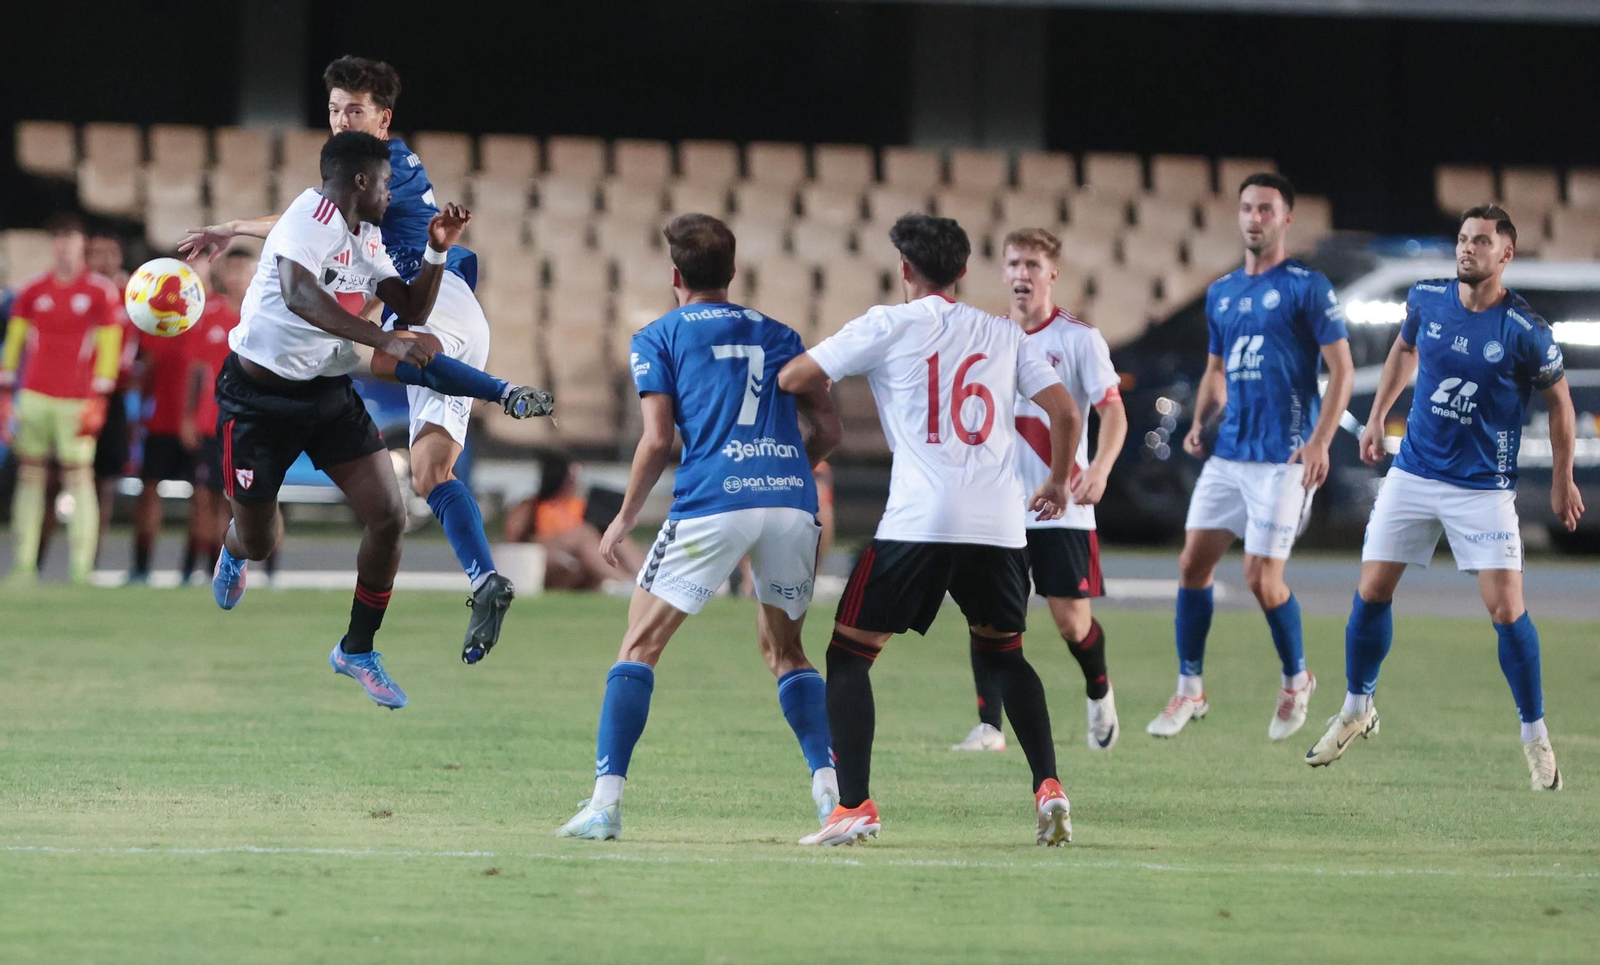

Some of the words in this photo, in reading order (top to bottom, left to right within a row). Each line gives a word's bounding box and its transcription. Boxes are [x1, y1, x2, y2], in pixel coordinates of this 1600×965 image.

[681, 308, 742, 322] indeso
[711, 345, 765, 426] 7
[925, 350, 995, 446] 16
[1450, 394, 1477, 413] Air
[1496, 430, 1508, 473] oxField
[742, 477, 765, 487] san
[766, 475, 804, 487] benito
